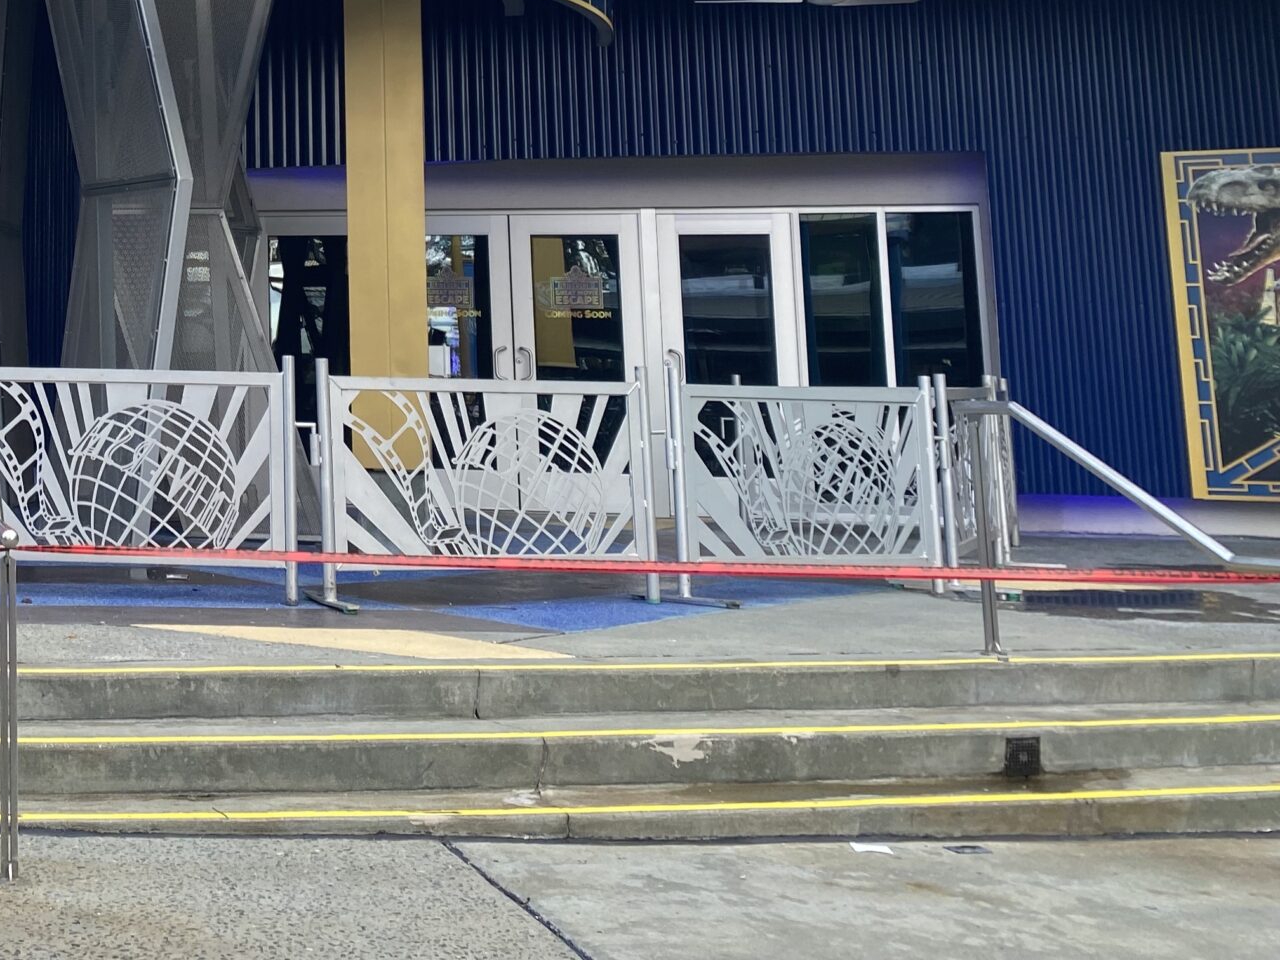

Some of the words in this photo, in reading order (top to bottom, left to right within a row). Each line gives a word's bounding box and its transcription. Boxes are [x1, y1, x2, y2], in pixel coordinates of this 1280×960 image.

[555, 295, 599, 305] ESCAPE
[544, 310, 583, 319] COMING
[584, 309, 612, 319] SOON
